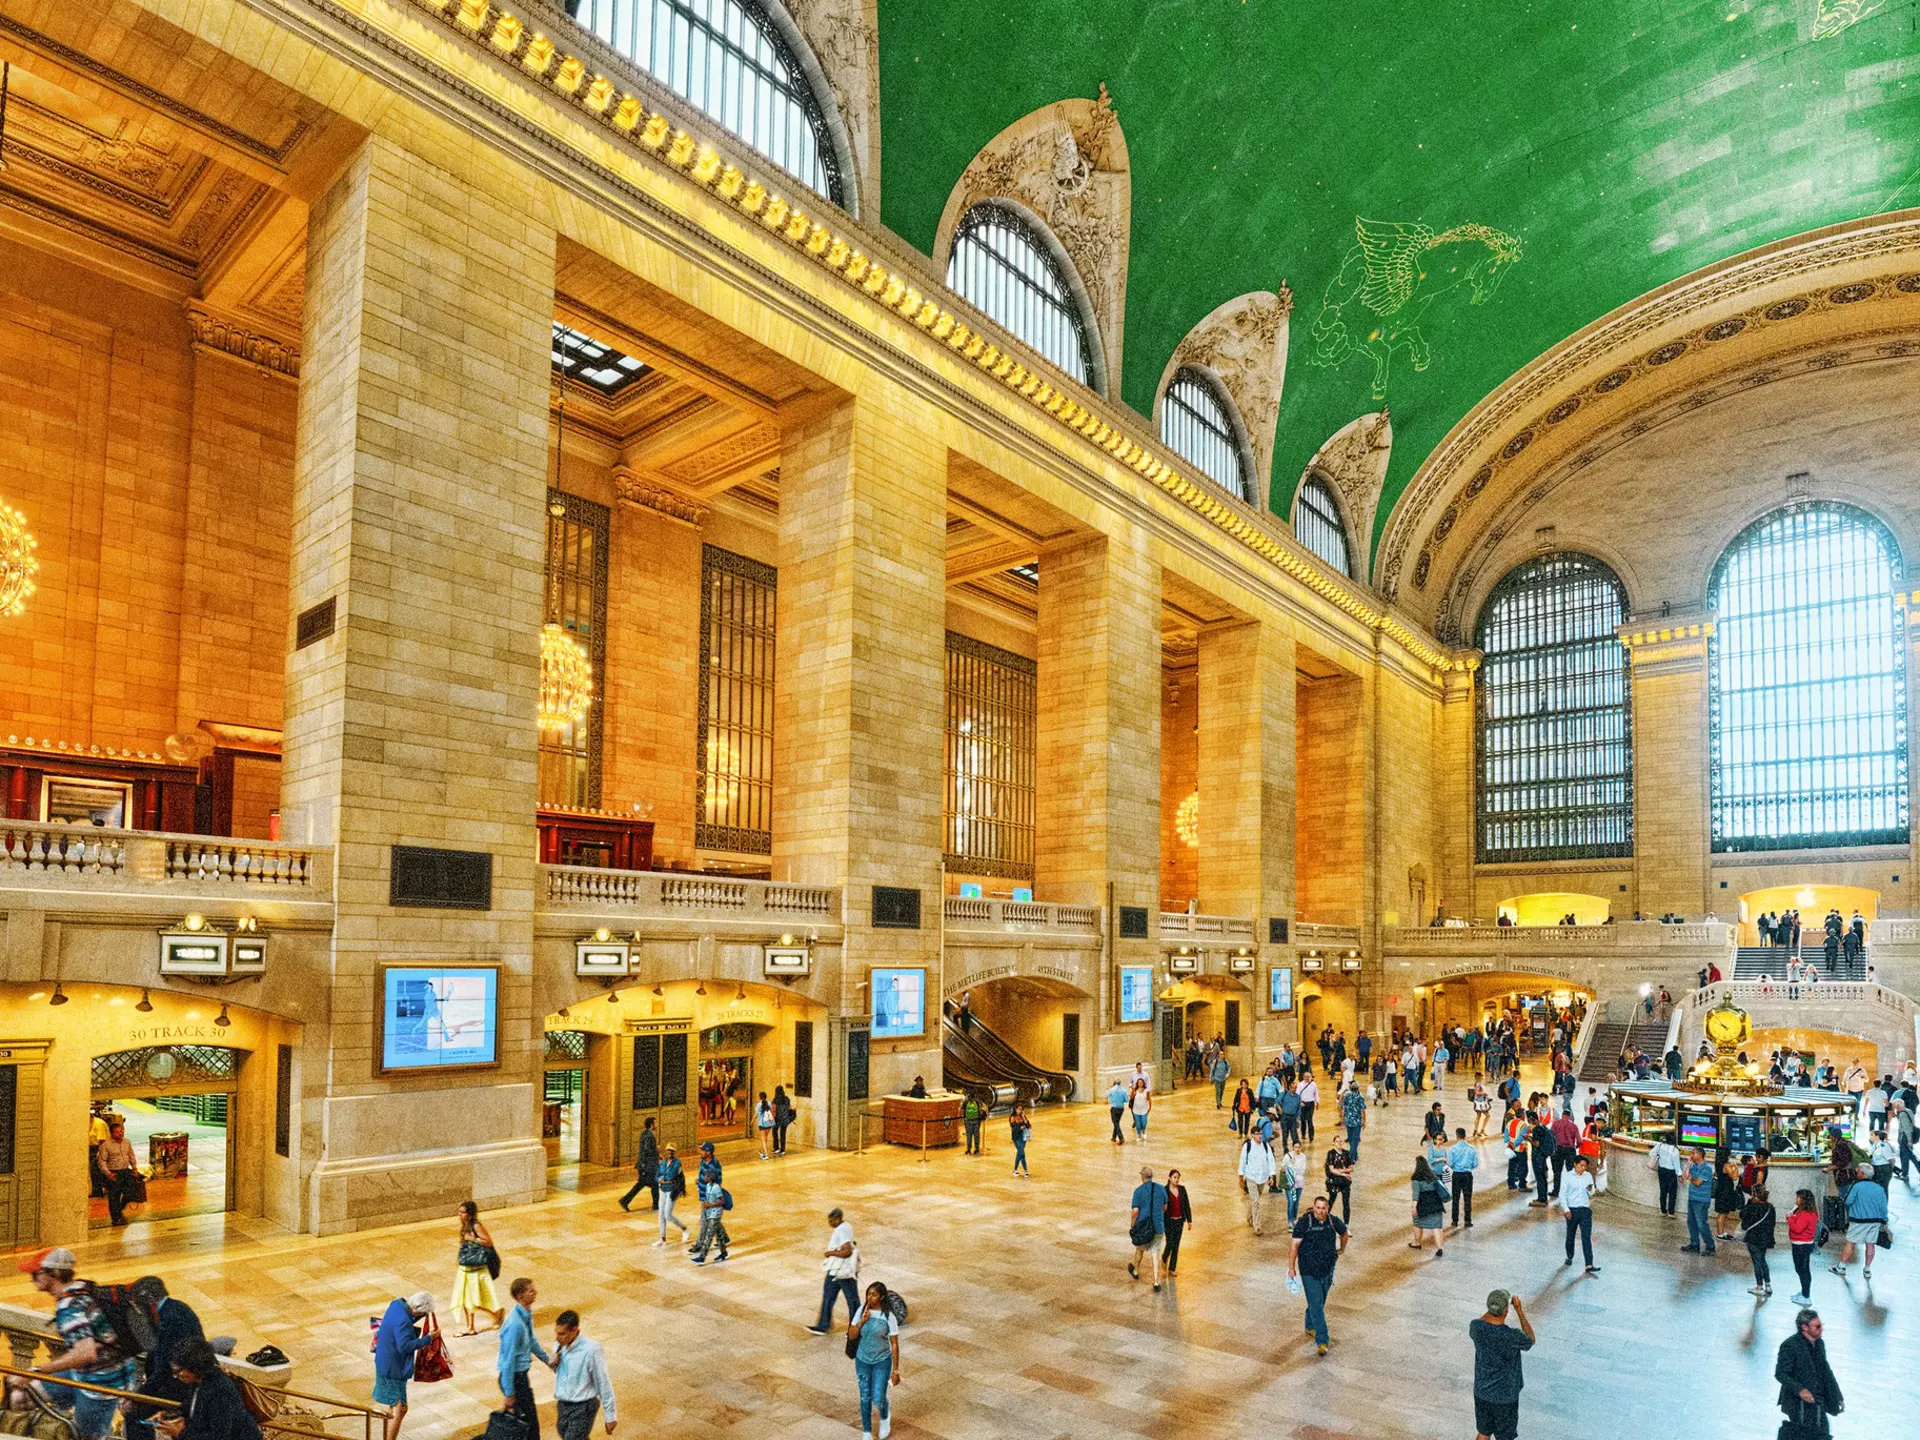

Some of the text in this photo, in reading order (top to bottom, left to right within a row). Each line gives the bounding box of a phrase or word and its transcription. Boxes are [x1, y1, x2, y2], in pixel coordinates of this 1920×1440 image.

[1513, 964, 1556, 976] LEXINGTON
[727, 1009, 755, 1018] TRACKS
[129, 1025, 226, 1041] 30 TRACK 30
